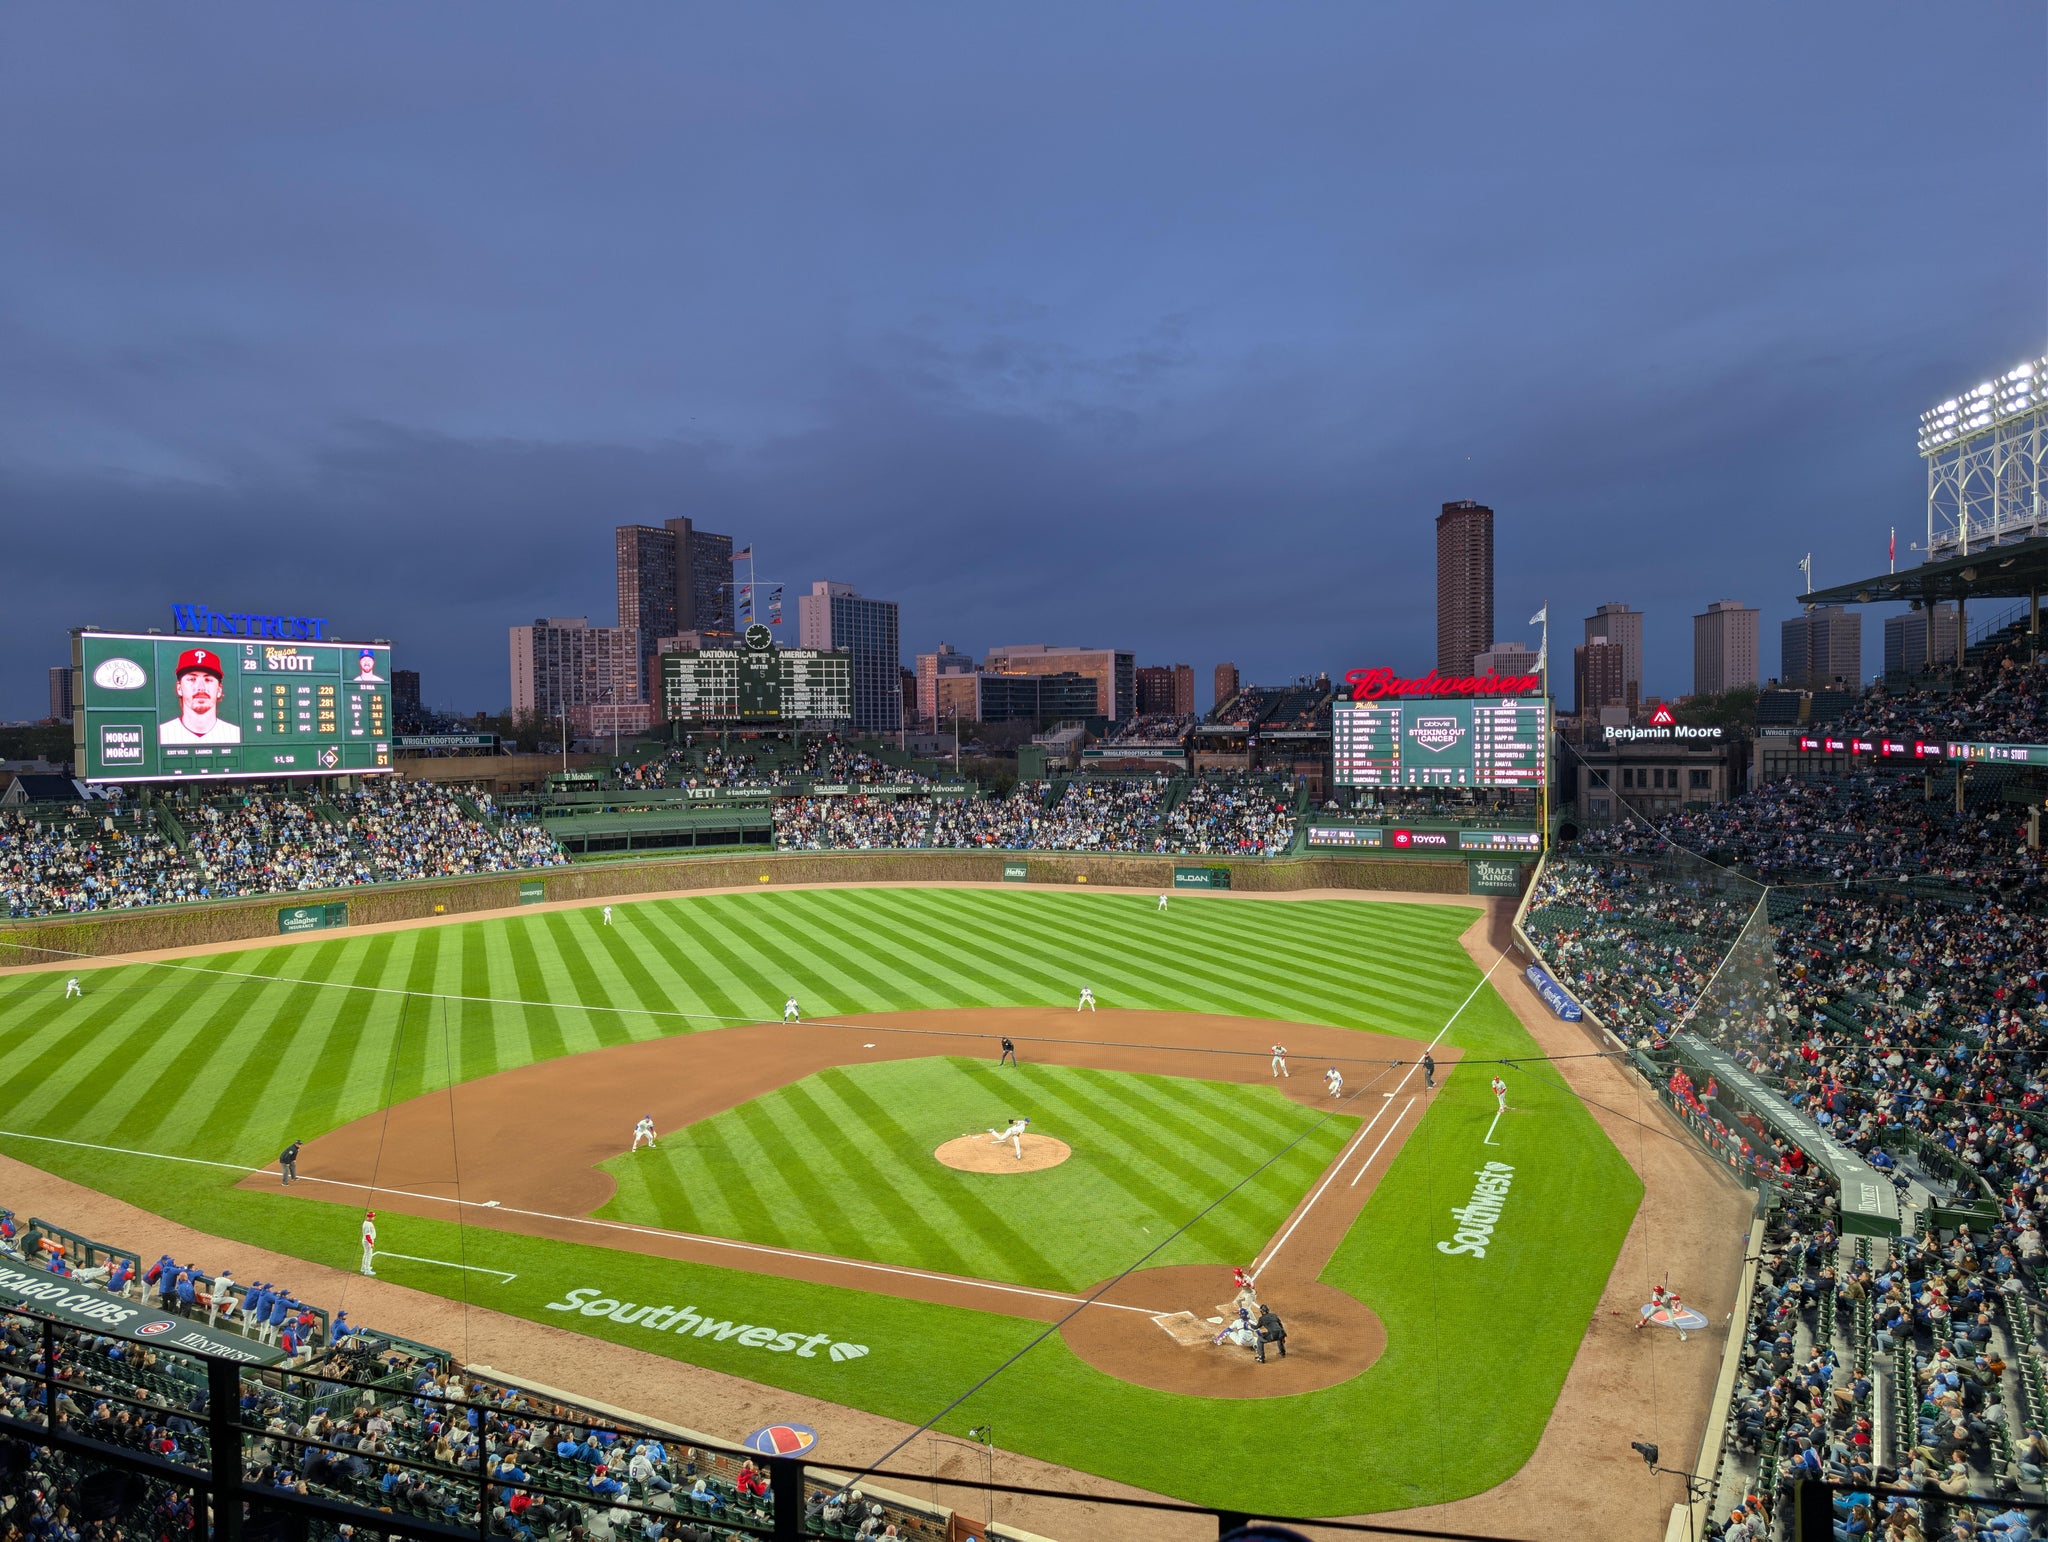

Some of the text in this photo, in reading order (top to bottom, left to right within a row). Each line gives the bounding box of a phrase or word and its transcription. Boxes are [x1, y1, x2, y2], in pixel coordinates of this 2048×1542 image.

[171, 603, 328, 639] WINTRUST
[246, 646, 254, 655] 5
[266, 647, 298, 660] Bryson
[700, 650, 740, 658] NATIONAL
[244, 660, 257, 670] 2B
[268, 656, 315, 671] STOTT
[1345, 666, 1539, 700] Budweiser
[318, 687, 334, 695] .220
[278, 699, 284, 707] 0
[319, 699, 334, 708] .281
[1502, 699, 1518, 707] Cubs
[278, 712, 284, 720] 3
[318, 712, 335, 720] .254
[279, 724, 285, 732] 2
[319, 724, 335, 732] .535
[106, 733, 139, 743] MORGAN
[1606, 726, 1722, 742] Benjamin Moore
[402, 736, 480, 746] WRIGLEYROOFTOPS.COM
[1859, 743, 1872, 751] TOYOTA
[1924, 746, 1940, 754] TOYOTA
[106, 748, 140, 758] MORGAN
[2011, 750, 2028, 760] STOTT
[378, 755, 388, 765] 51
[1409, 775, 1416, 783] 2
[1423, 775, 1430, 783] 2
[1444, 775, 1450, 783] 2
[1459, 775, 1465, 783] 4
[687, 788, 716, 798] YETI
[731, 788, 771, 797] tastytrade
[814, 785, 849, 793] GRAINGER
[859, 785, 912, 794] Budweiser
[931, 785, 965, 793] Advocate
[1412, 835, 1446, 845] TOYOTA
[1006, 868, 1026, 877] Hefty
[1478, 866, 1515, 875] DRAFT
[1482, 874, 1513, 882] KINGS
[284, 917, 318, 927] Gallagher
[1436, 1170, 1515, 1259] Southwest
[56, 1295, 139, 1323] CUBS
[545, 1288, 832, 1358] Southwest
[178, 1332, 258, 1362] WINTRUST
[632, 1467, 637, 1477] 8
